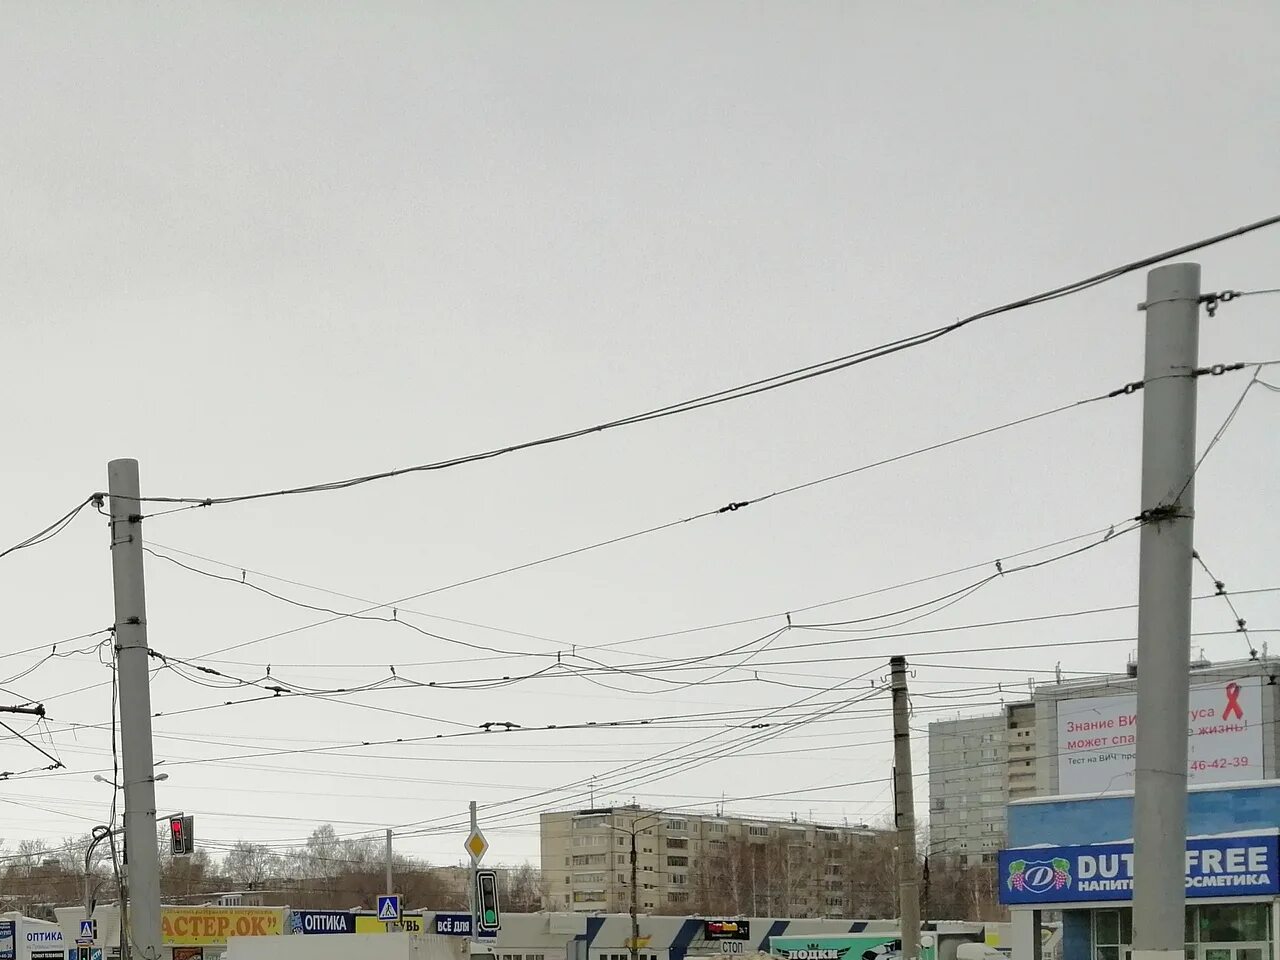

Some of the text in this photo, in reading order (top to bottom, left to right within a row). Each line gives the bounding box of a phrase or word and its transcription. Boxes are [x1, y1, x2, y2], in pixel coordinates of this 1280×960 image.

[1067, 715, 1136, 732] Знание ВИ
[1067, 735, 1136, 749] может спа
[1191, 757, 1248, 771] 46-42-39
[1078, 854, 1134, 879] DUT
[1185, 847, 1268, 874] FREE
[305, 914, 347, 930] ОПТИКА
[437, 917, 452, 932] ВСЁ
[453, 919, 470, 932] ДЛЯ
[26, 932, 63, 942] ОПТИКА
[722, 941, 743, 953] СТОП
[788, 949, 838, 960] ЛОДКИ
